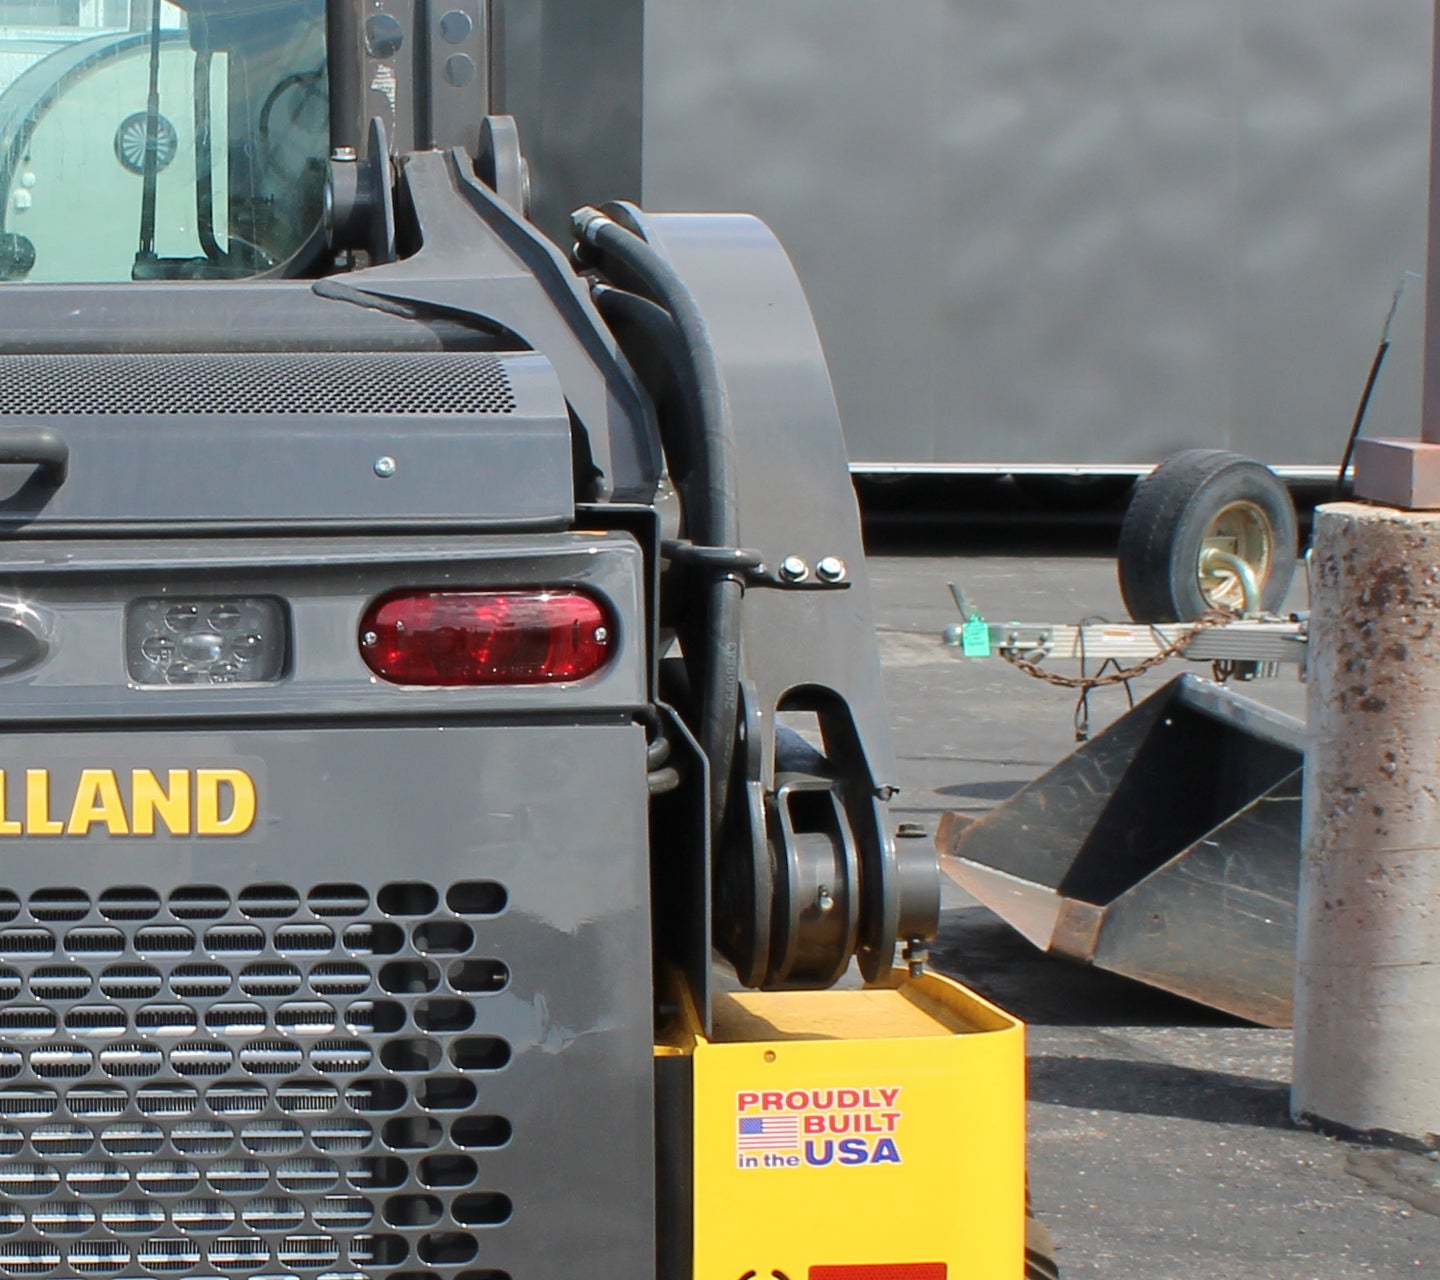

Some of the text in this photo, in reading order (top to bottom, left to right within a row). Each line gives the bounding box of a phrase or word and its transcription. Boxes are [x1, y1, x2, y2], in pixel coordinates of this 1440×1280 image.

[737, 1088, 900, 1112] PROUDLY
[803, 1113, 901, 1134] BUILT
[738, 1138, 902, 1167] in the USA
